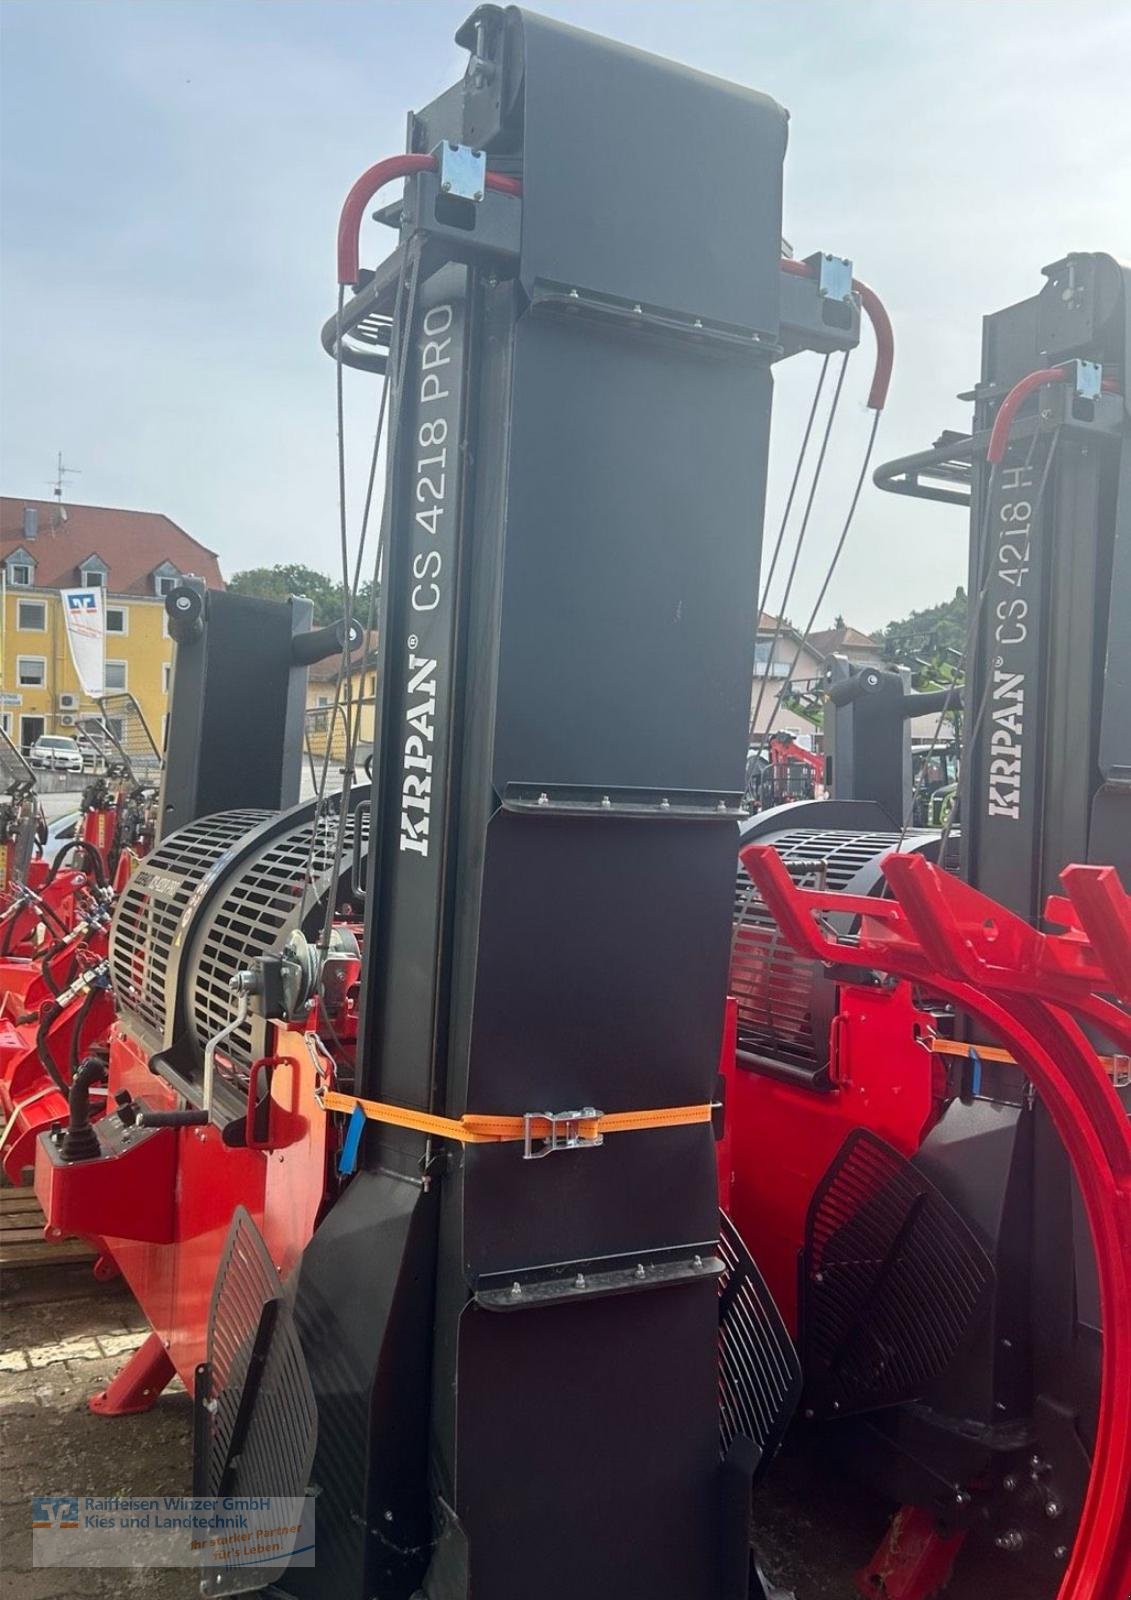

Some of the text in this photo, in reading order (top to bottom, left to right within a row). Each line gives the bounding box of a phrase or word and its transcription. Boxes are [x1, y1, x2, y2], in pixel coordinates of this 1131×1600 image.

[420, 304, 453, 403] PRO
[415, 417, 448, 534] 4218
[1001, 466, 1034, 491] H
[411, 550, 442, 611] CS
[998, 501, 1032, 587] 4218
[995, 599, 1028, 644] CS
